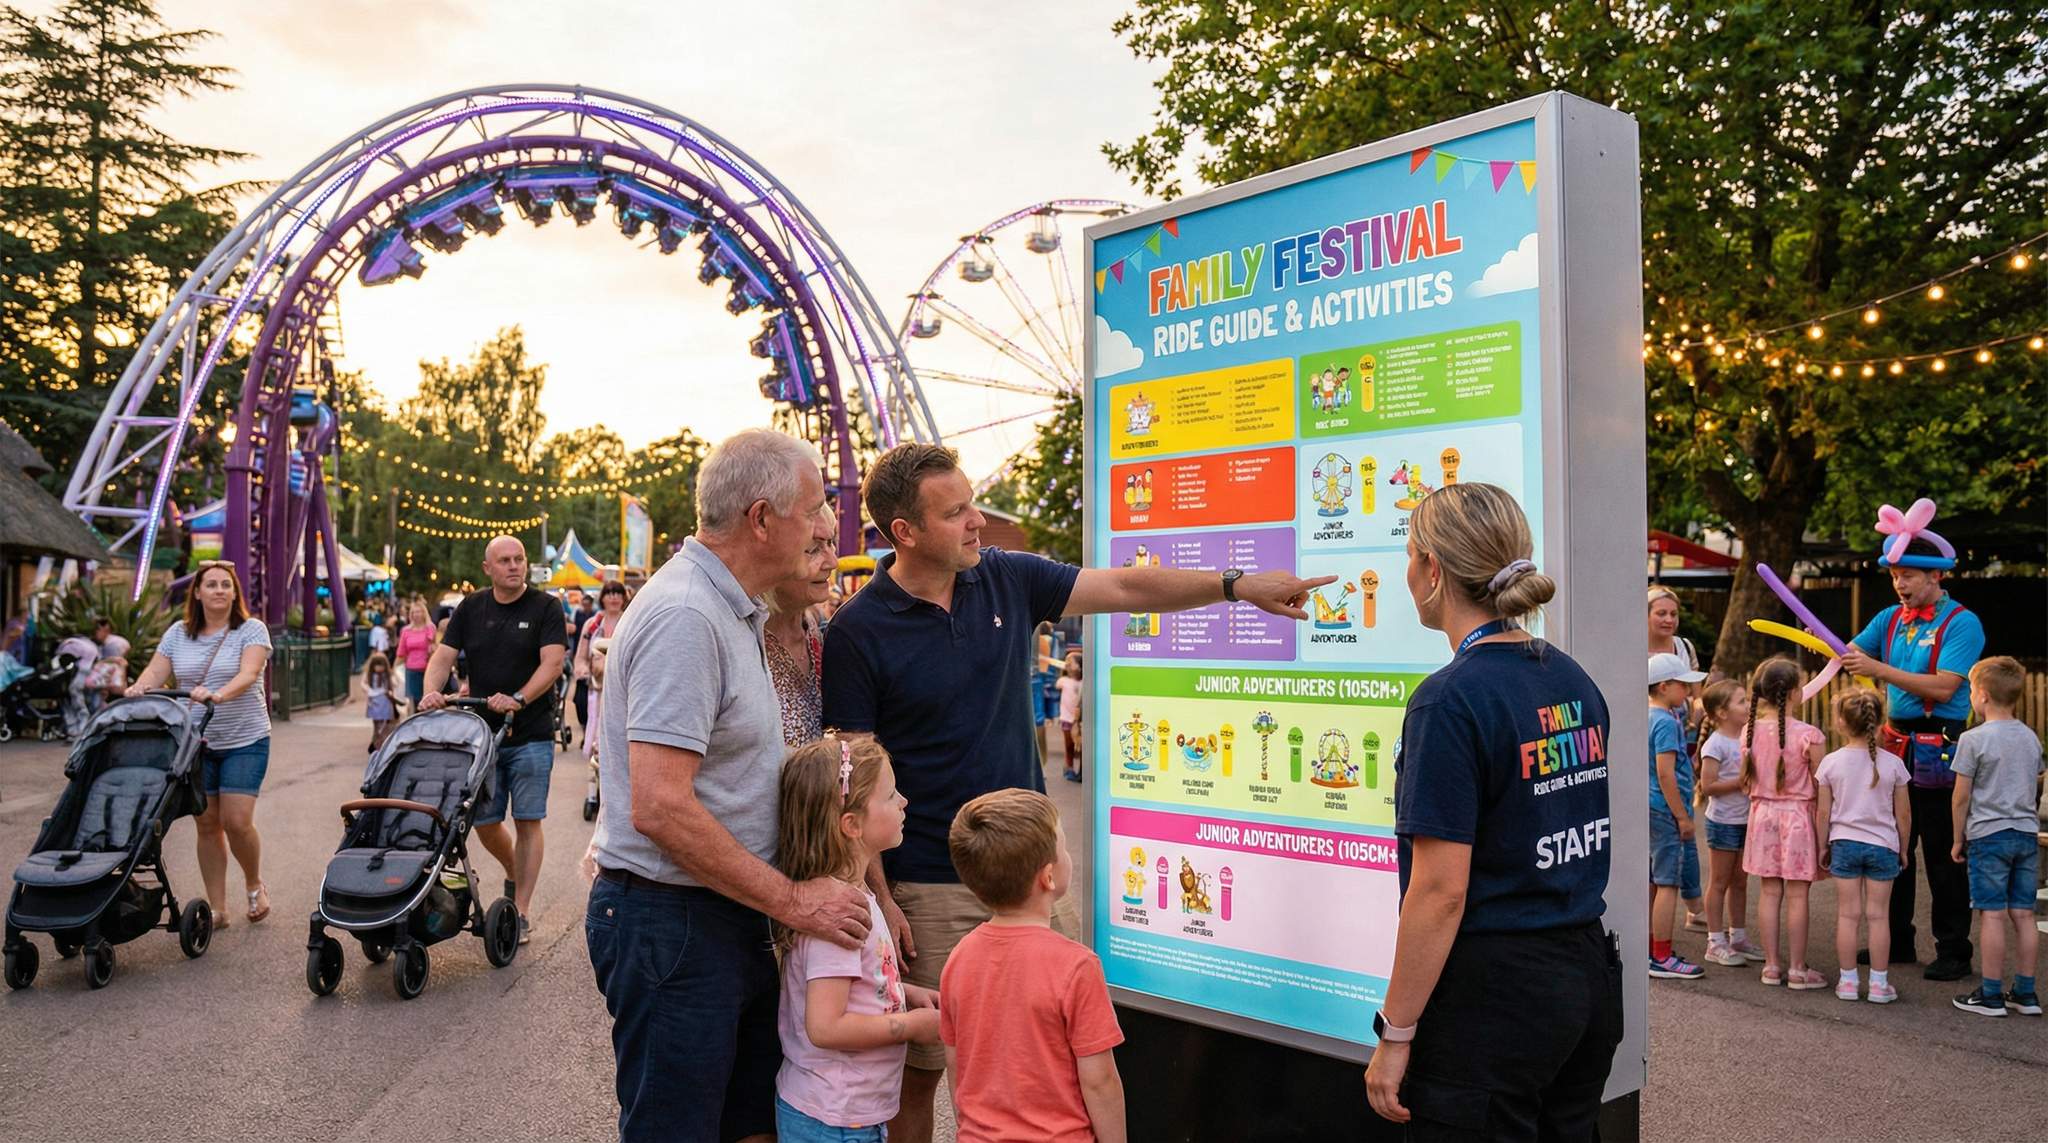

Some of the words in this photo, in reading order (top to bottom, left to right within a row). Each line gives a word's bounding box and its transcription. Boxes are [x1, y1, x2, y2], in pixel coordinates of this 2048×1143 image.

[1149, 245, 1264, 316] FAMILY
[1273, 200, 1463, 290] FESTIVAL
[1153, 319, 1204, 357] RIDE
[1209, 305, 1278, 346] GUIDE
[1285, 299, 1304, 331] &
[1309, 271, 1454, 328] ACTIVITIES
[1195, 676, 1240, 694] JUNIOR
[1243, 677, 1336, 697] ADVENTURERS
[1339, 679, 1405, 701] (105CM+)
[1537, 701, 1583, 734] FAMILY
[1196, 823, 1240, 845] JUNIOR
[1242, 828, 1335, 857] ADVENTURERS
[1338, 839, 1398, 864] (105CM+
[1535, 817, 1610, 870] STAFF
